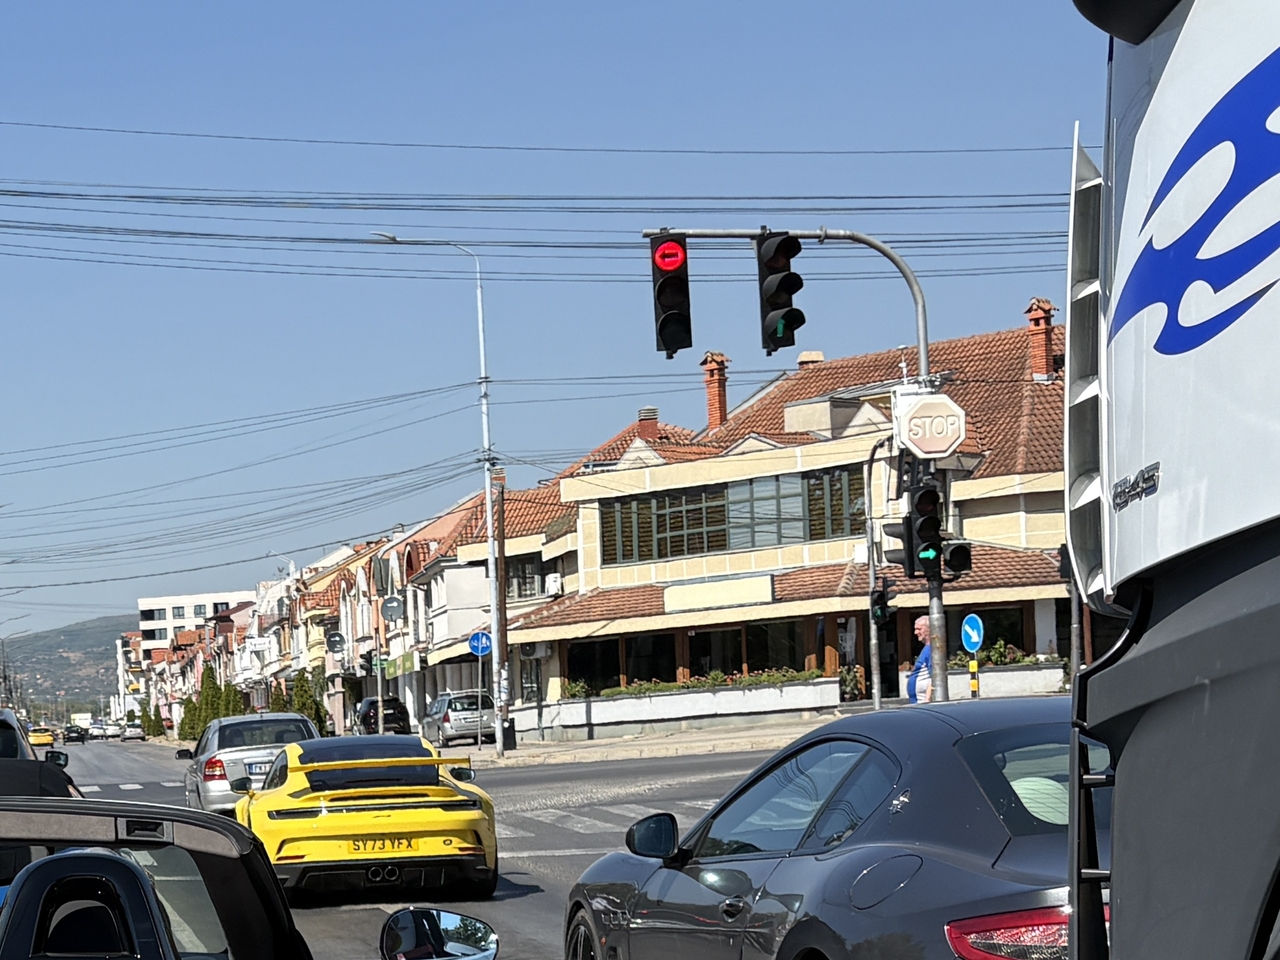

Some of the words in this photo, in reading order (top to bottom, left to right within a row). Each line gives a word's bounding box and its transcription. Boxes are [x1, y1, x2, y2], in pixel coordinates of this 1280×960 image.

[909, 415, 959, 439] STOP
[353, 838, 386, 851] SY73
[389, 837, 413, 850] YFX
